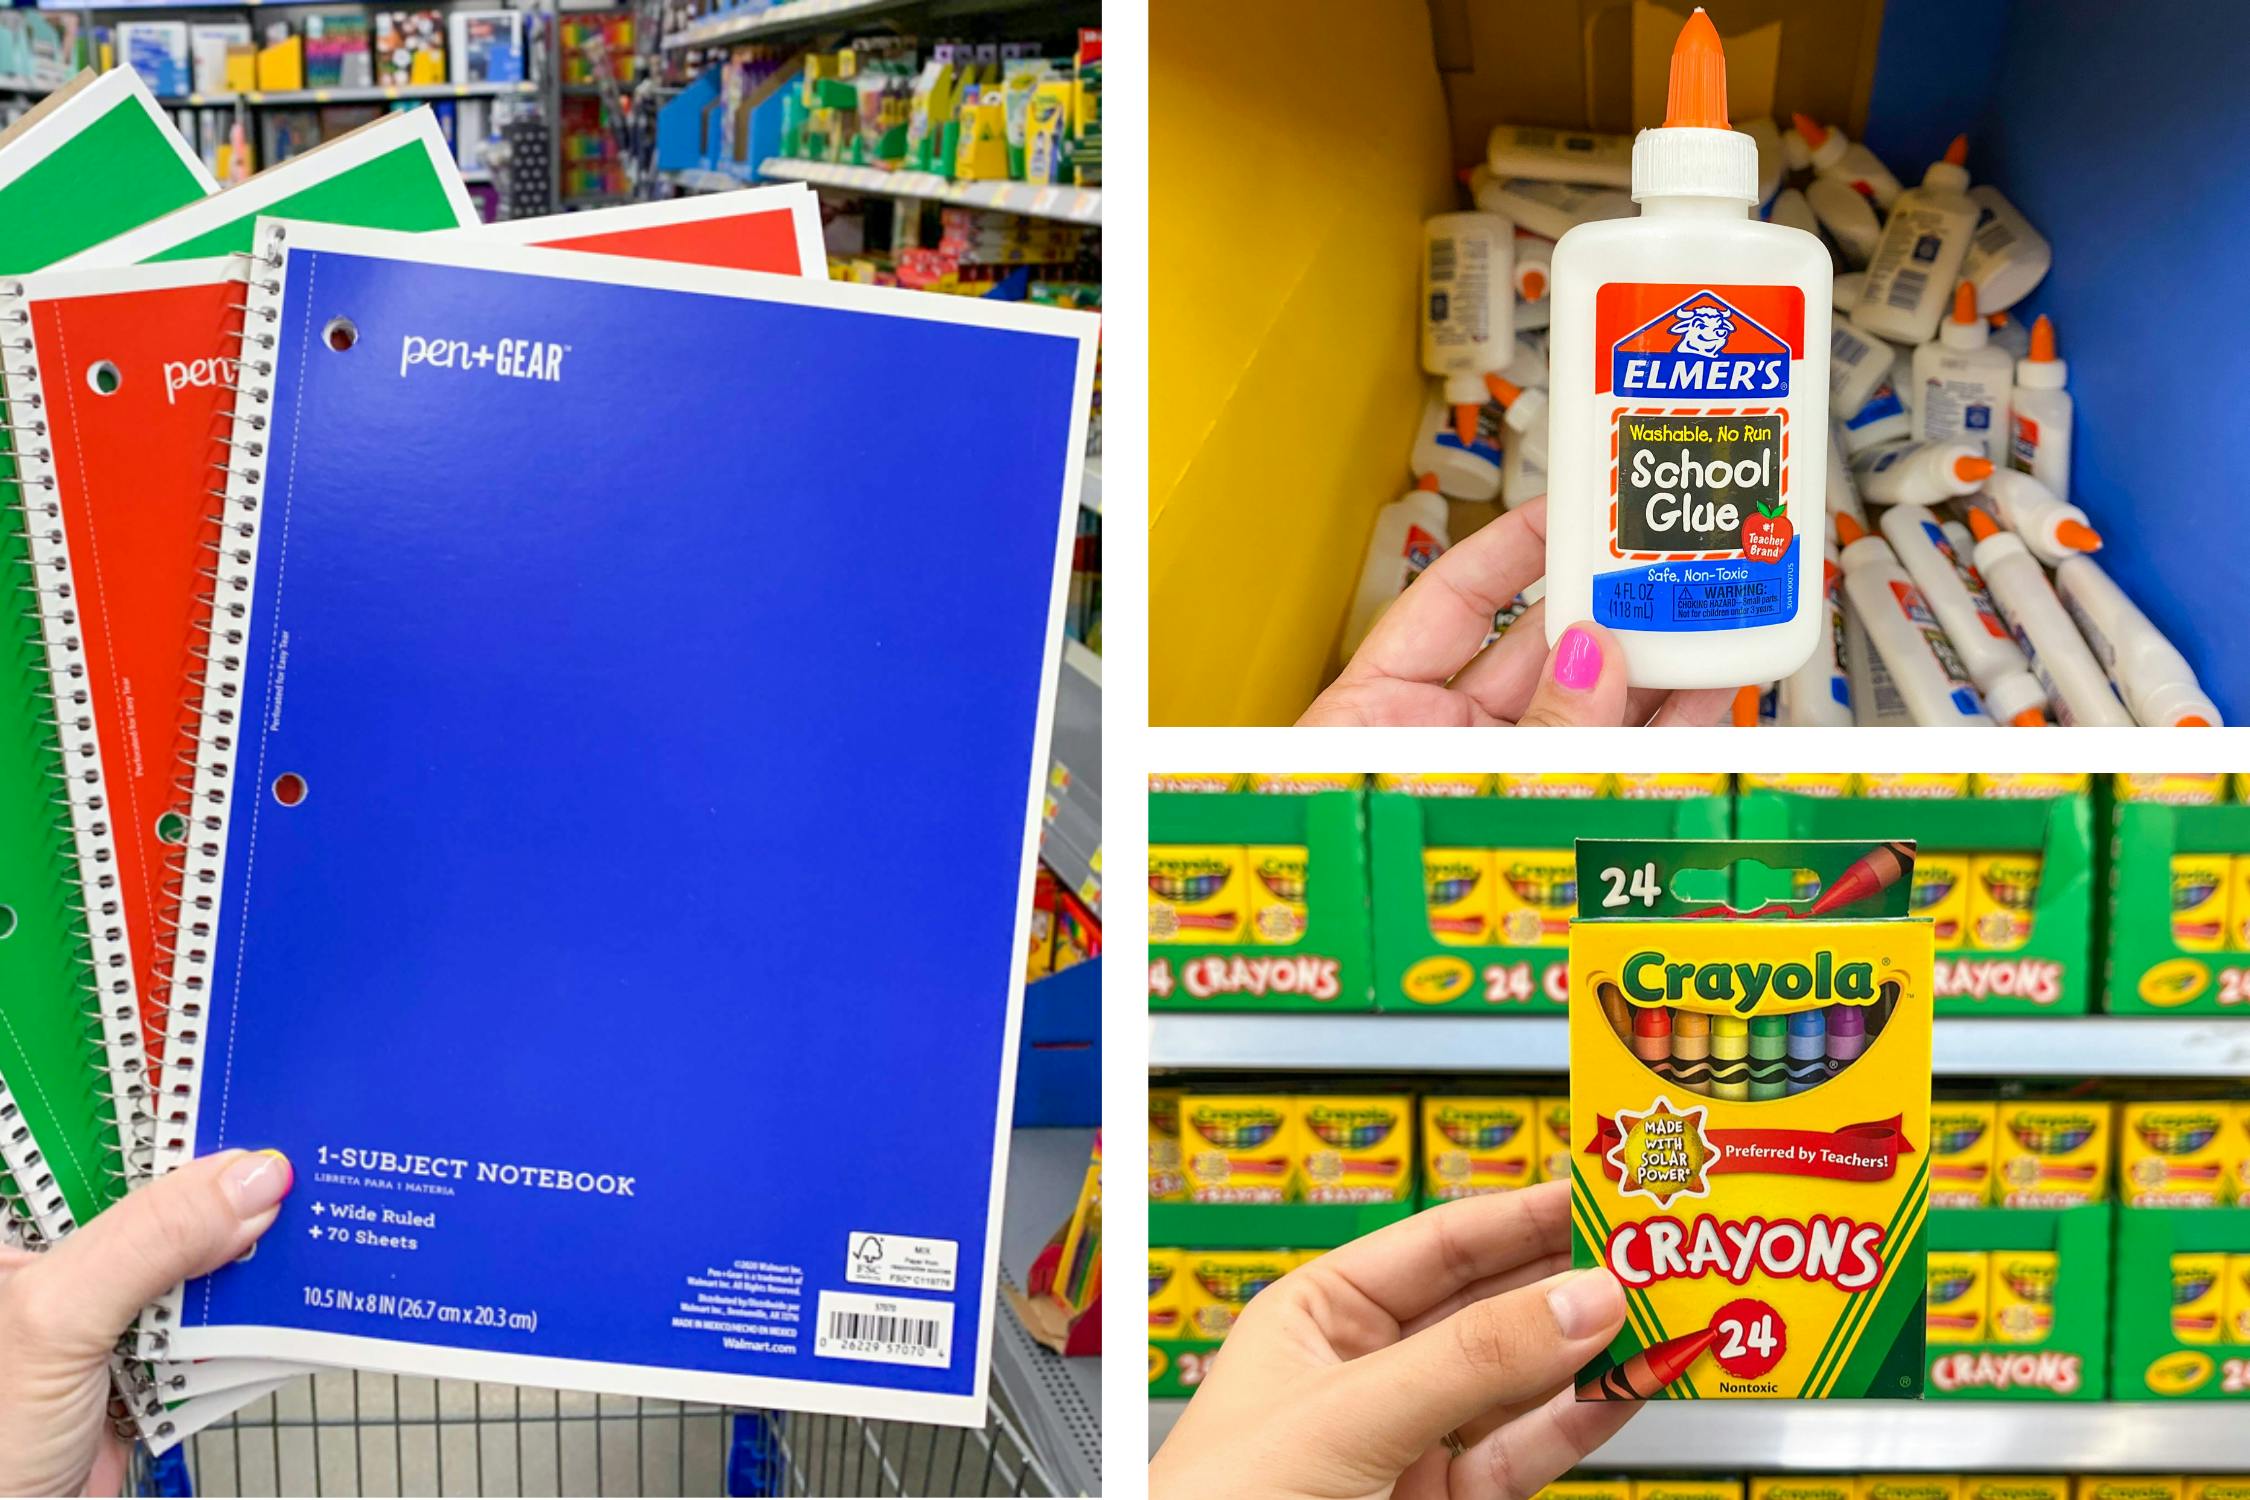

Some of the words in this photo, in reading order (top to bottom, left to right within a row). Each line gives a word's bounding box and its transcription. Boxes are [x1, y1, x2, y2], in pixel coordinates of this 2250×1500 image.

[1623, 359, 1782, 391] ELMER'S
[1717, 425, 1740, 443] No
[1743, 425, 1771, 443] Run
[1631, 447, 1771, 489] School
[1645, 492, 1740, 533] Glue
[1748, 532, 1785, 547] Teacher
[1750, 546, 1779, 558] Brand
[1683, 567, 1749, 583] Non-Toxic
[1614, 586, 1622, 600] 4
[1623, 585, 1637, 600] FL
[1638, 583, 1655, 600] OZ
[1704, 583, 1768, 600] WARNING:
[1609, 600, 1631, 619] (118
[1633, 600, 1654, 621] mL)
[1677, 600, 1708, 609] CHOKING
[1678, 609, 1690, 618] Not
[1691, 609, 1701, 618] for
[1702, 607, 1730, 618] children
[1730, 606, 1749, 616] under
[1600, 862, 1662, 908] 24
[1184, 954, 1340, 1000] CRAYONS
[1485, 962, 1536, 1003] 24
[1623, 951, 1875, 1013] Crayola
[1934, 958, 2062, 1004] RAYONS
[1644, 1120, 1684, 1135] MADE
[1645, 1136, 1683, 1151] WITH
[1641, 1152, 1688, 1168] SOLAR
[1725, 1144, 1796, 1160] Preferred
[1798, 1146, 1816, 1164] by
[1819, 1148, 1889, 1168] Teachers!
[317, 1145, 469, 1179] 1-SUBJECT
[476, 1161, 636, 1196] NOTEBOOK
[314, 1172, 361, 1186] LIBRETA
[364, 1178, 394, 1190] PARA
[405, 1182, 455, 1196] MATERIA
[329, 1203, 378, 1223] Wide
[381, 1208, 437, 1229] Ruled
[327, 1227, 350, 1243] 70
[355, 1230, 418, 1250] Sheets
[1611, 1219, 1880, 1287] CRAYONS
[303, 1286, 334, 1308] 10.5
[336, 1289, 354, 1310] IN
[355, 1297, 365, 1311] x
[366, 1294, 377, 1313] 8
[379, 1294, 395, 1315] IN
[398, 1296, 435, 1320] (26.7
[437, 1305, 460, 1323] cm
[463, 1310, 472, 1324] x
[475, 1305, 508, 1328] 20.3
[509, 1310, 538, 1333] cm)
[722, 1336, 797, 1355] Walmart.com
[1718, 1314, 1778, 1359] 24
[1932, 1350, 2082, 1393] CRAYONS
[1719, 1382, 1778, 1394] Nontoxic
